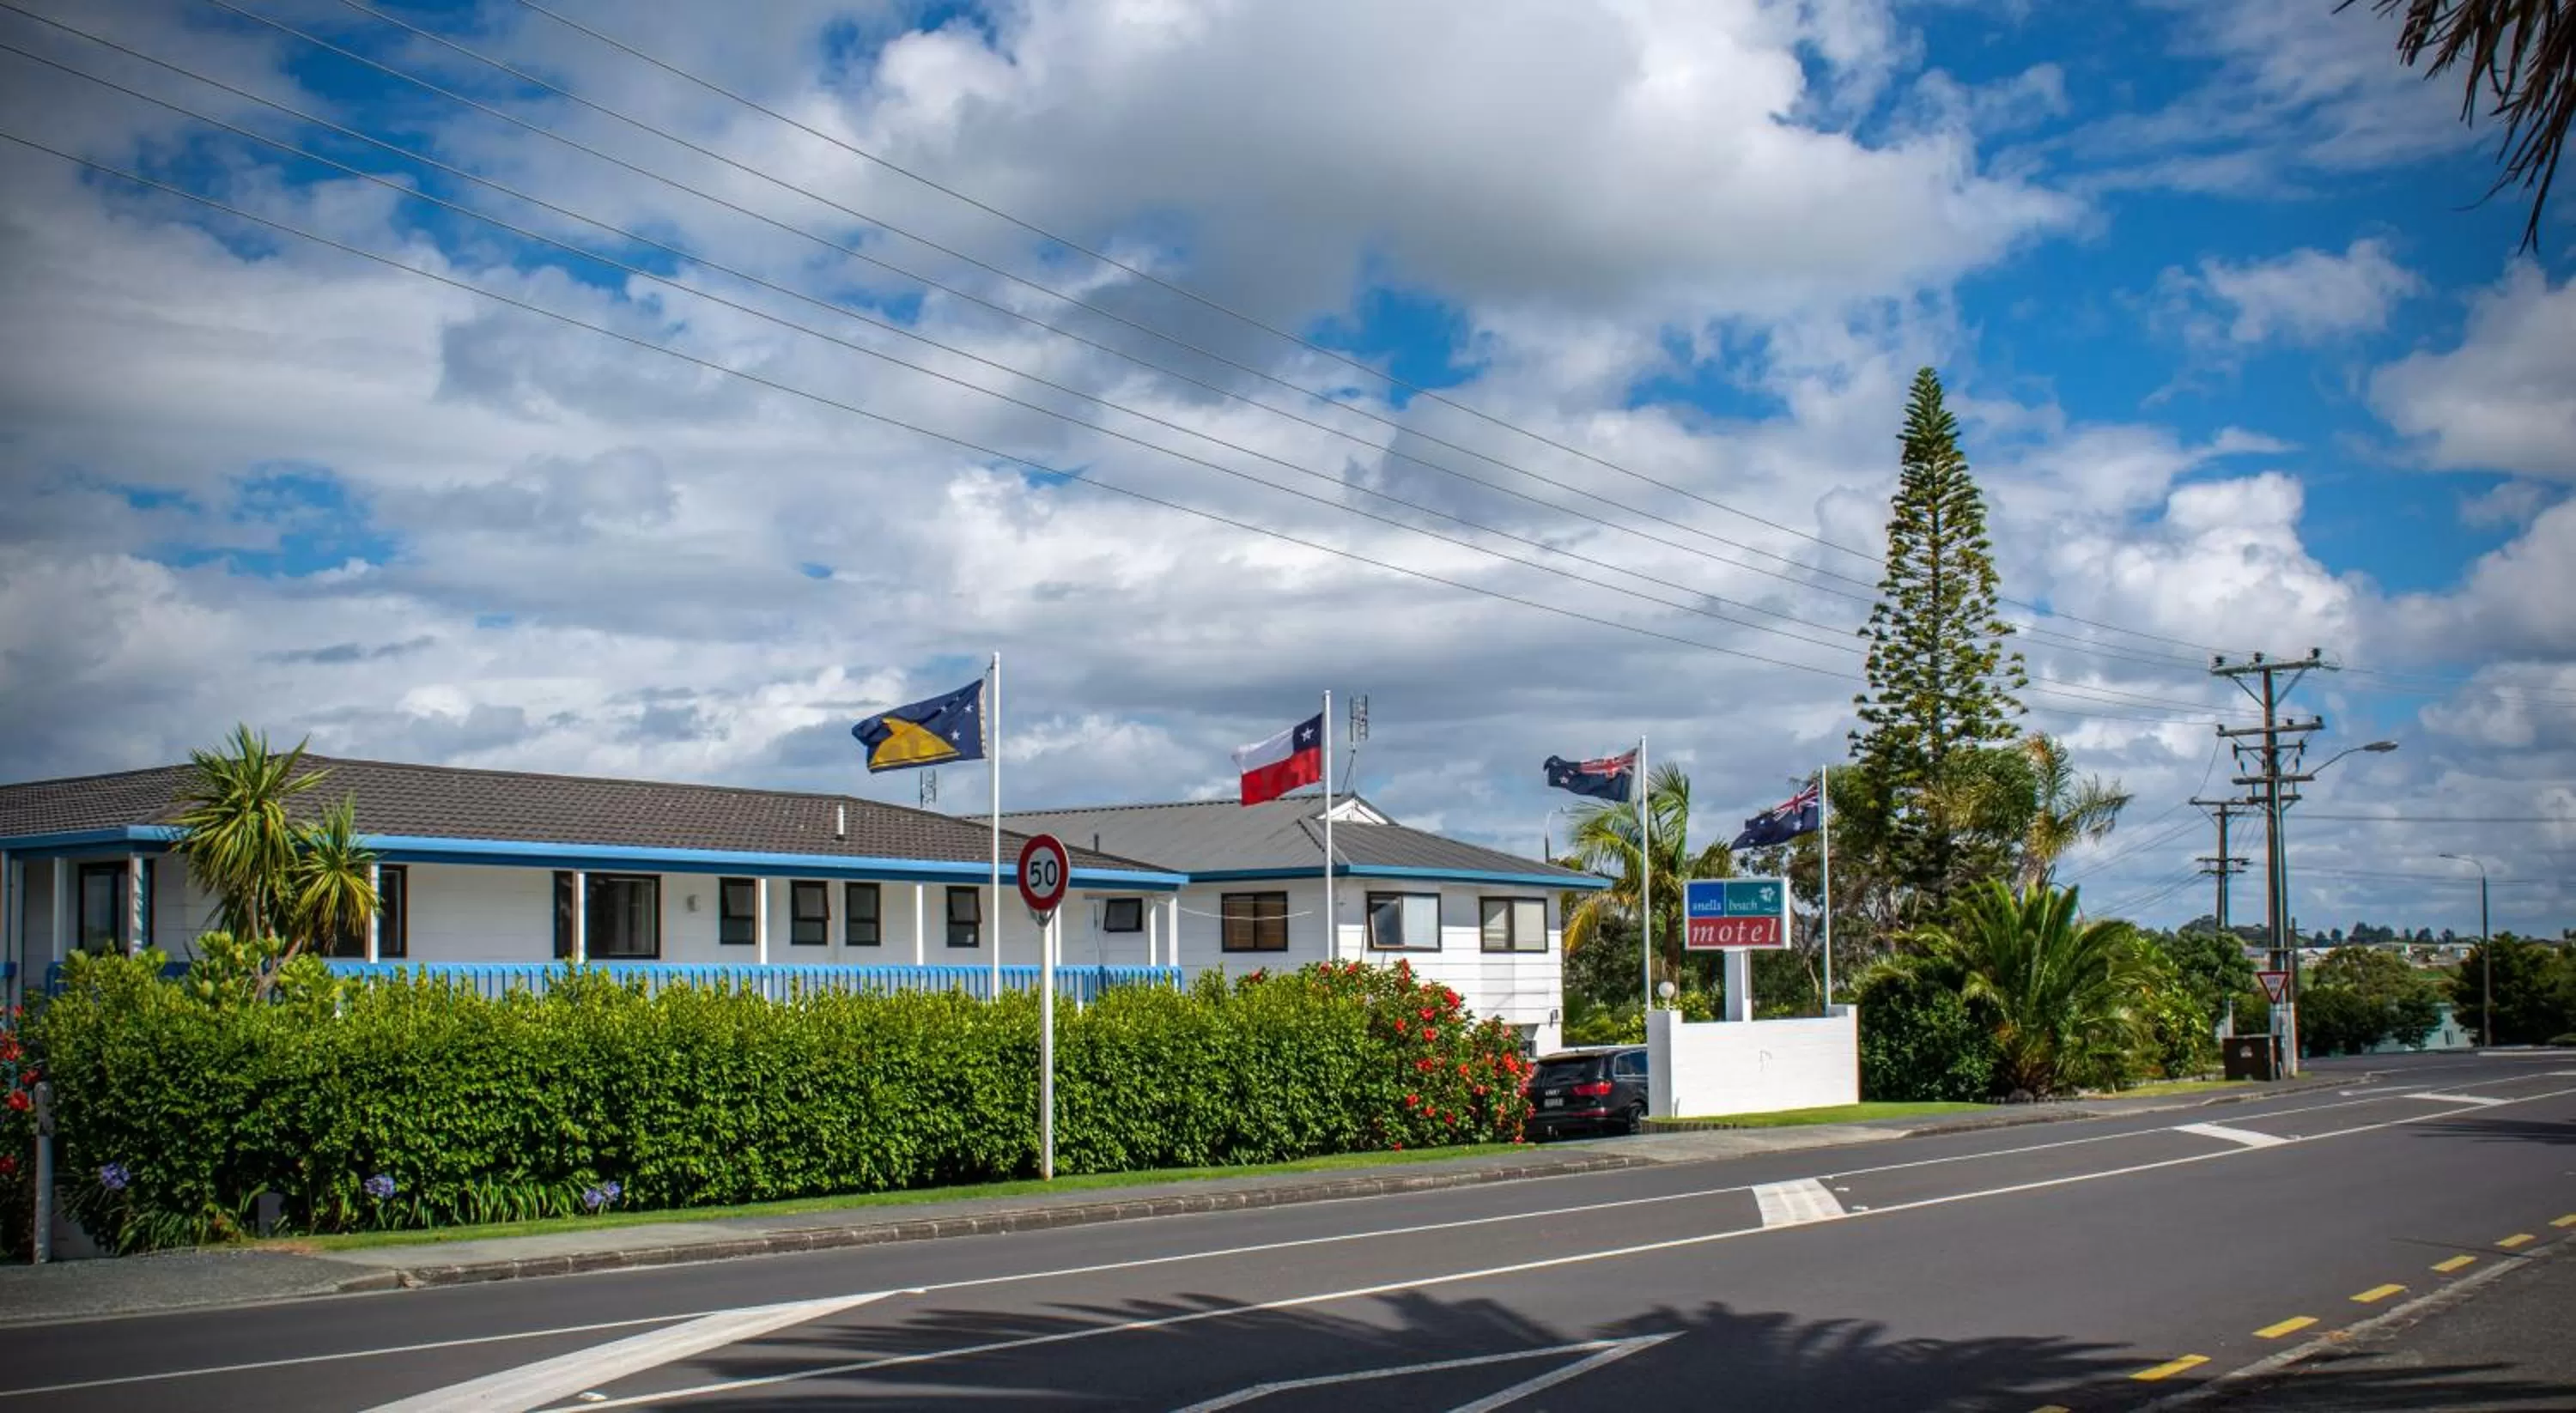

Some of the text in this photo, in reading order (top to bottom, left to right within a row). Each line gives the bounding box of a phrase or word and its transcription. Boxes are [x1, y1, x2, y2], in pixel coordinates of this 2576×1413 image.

[1030, 859, 1057, 887] 50
[1692, 899, 1722, 911] snells
[1692, 918, 1777, 943] motel
